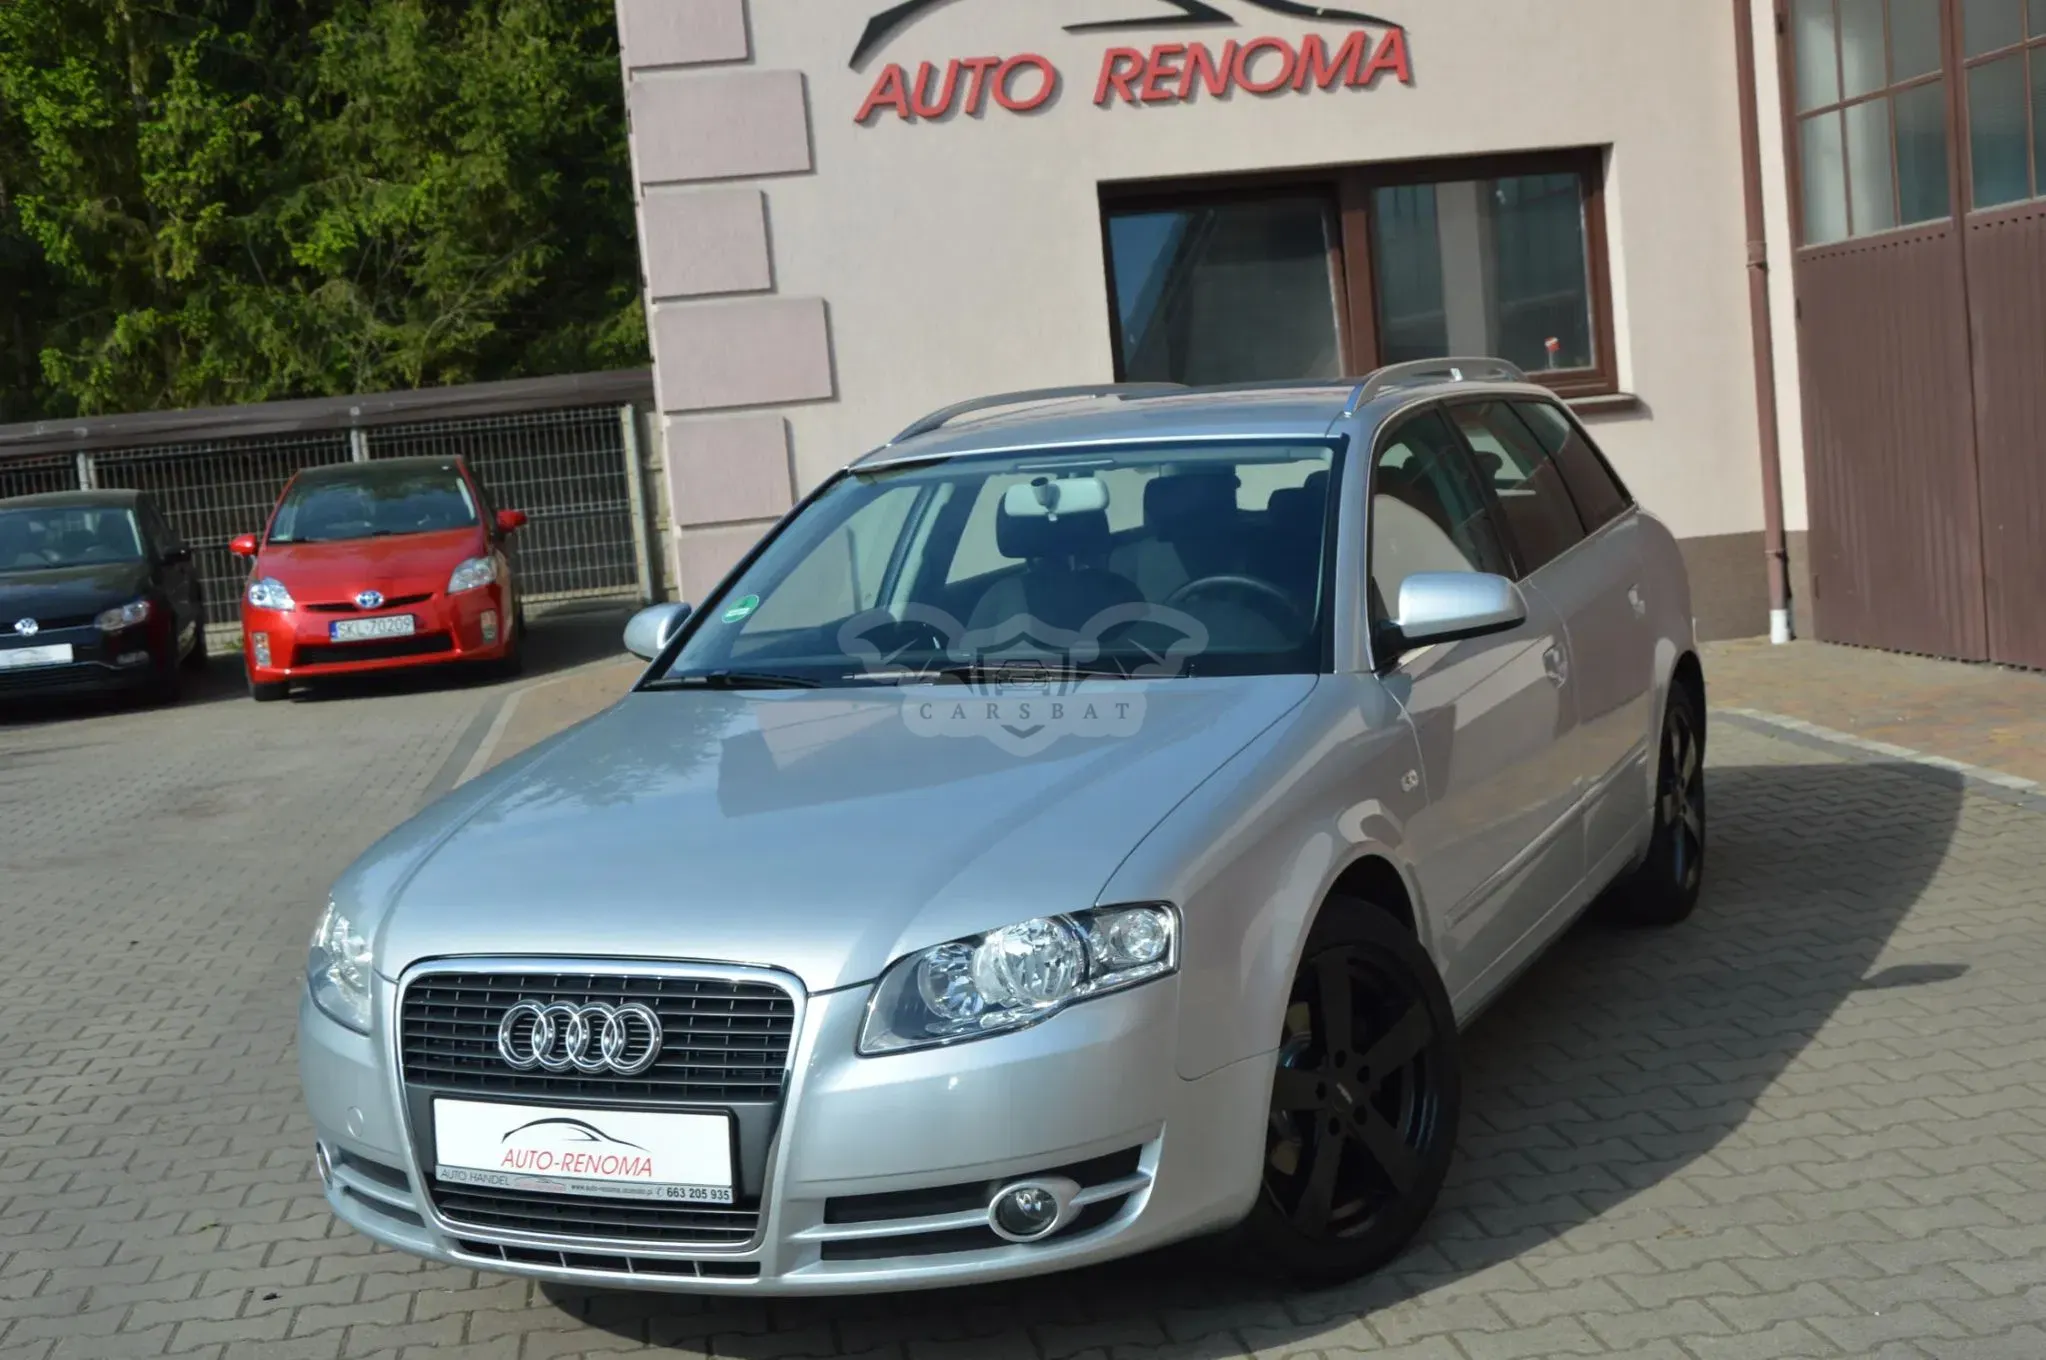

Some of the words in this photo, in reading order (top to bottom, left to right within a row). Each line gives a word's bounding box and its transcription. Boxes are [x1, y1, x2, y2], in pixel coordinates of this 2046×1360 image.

[854, 52, 1057, 124] AUTO
[1093, 27, 1412, 106] RENOMA
[500, 1148, 653, 1177] AUTO-RENOMA
[440, 1168, 467, 1181] AUTO
[469, 1171, 510, 1186] HANDEL
[666, 1187, 686, 1199] 663
[689, 1188, 708, 1200] 205
[710, 1189, 730, 1201] 935
